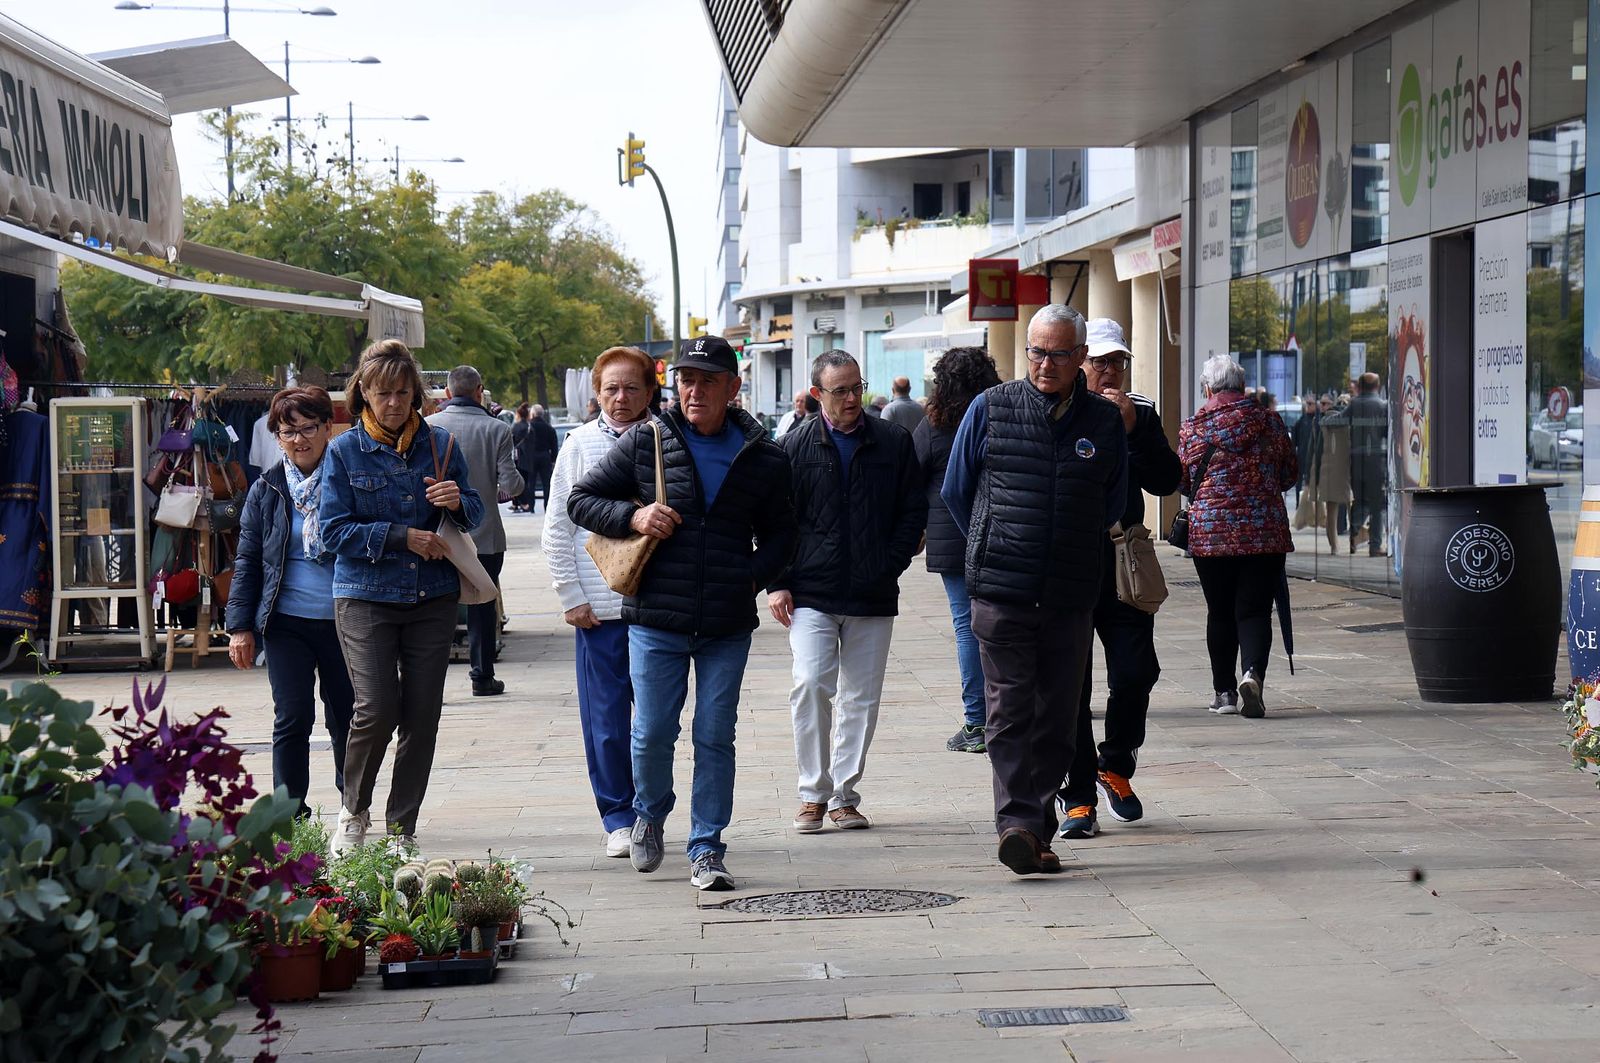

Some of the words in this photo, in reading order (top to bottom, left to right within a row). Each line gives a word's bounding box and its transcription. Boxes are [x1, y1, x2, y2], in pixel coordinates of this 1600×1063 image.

[1427, 54, 1522, 189] gafas.es
[58, 98, 149, 224] MANOLI
[1479, 249, 1509, 282] Precisión
[1479, 287, 1508, 315] alemana
[1479, 348, 1486, 368] en
[1487, 339, 1523, 374] progresivas
[1483, 379, 1499, 405] todos
[1500, 381, 1510, 405] tus
[1478, 413, 1498, 438] extras
[1449, 528, 1511, 563] VALDESPINO
[1459, 571, 1503, 588] JEREZ
